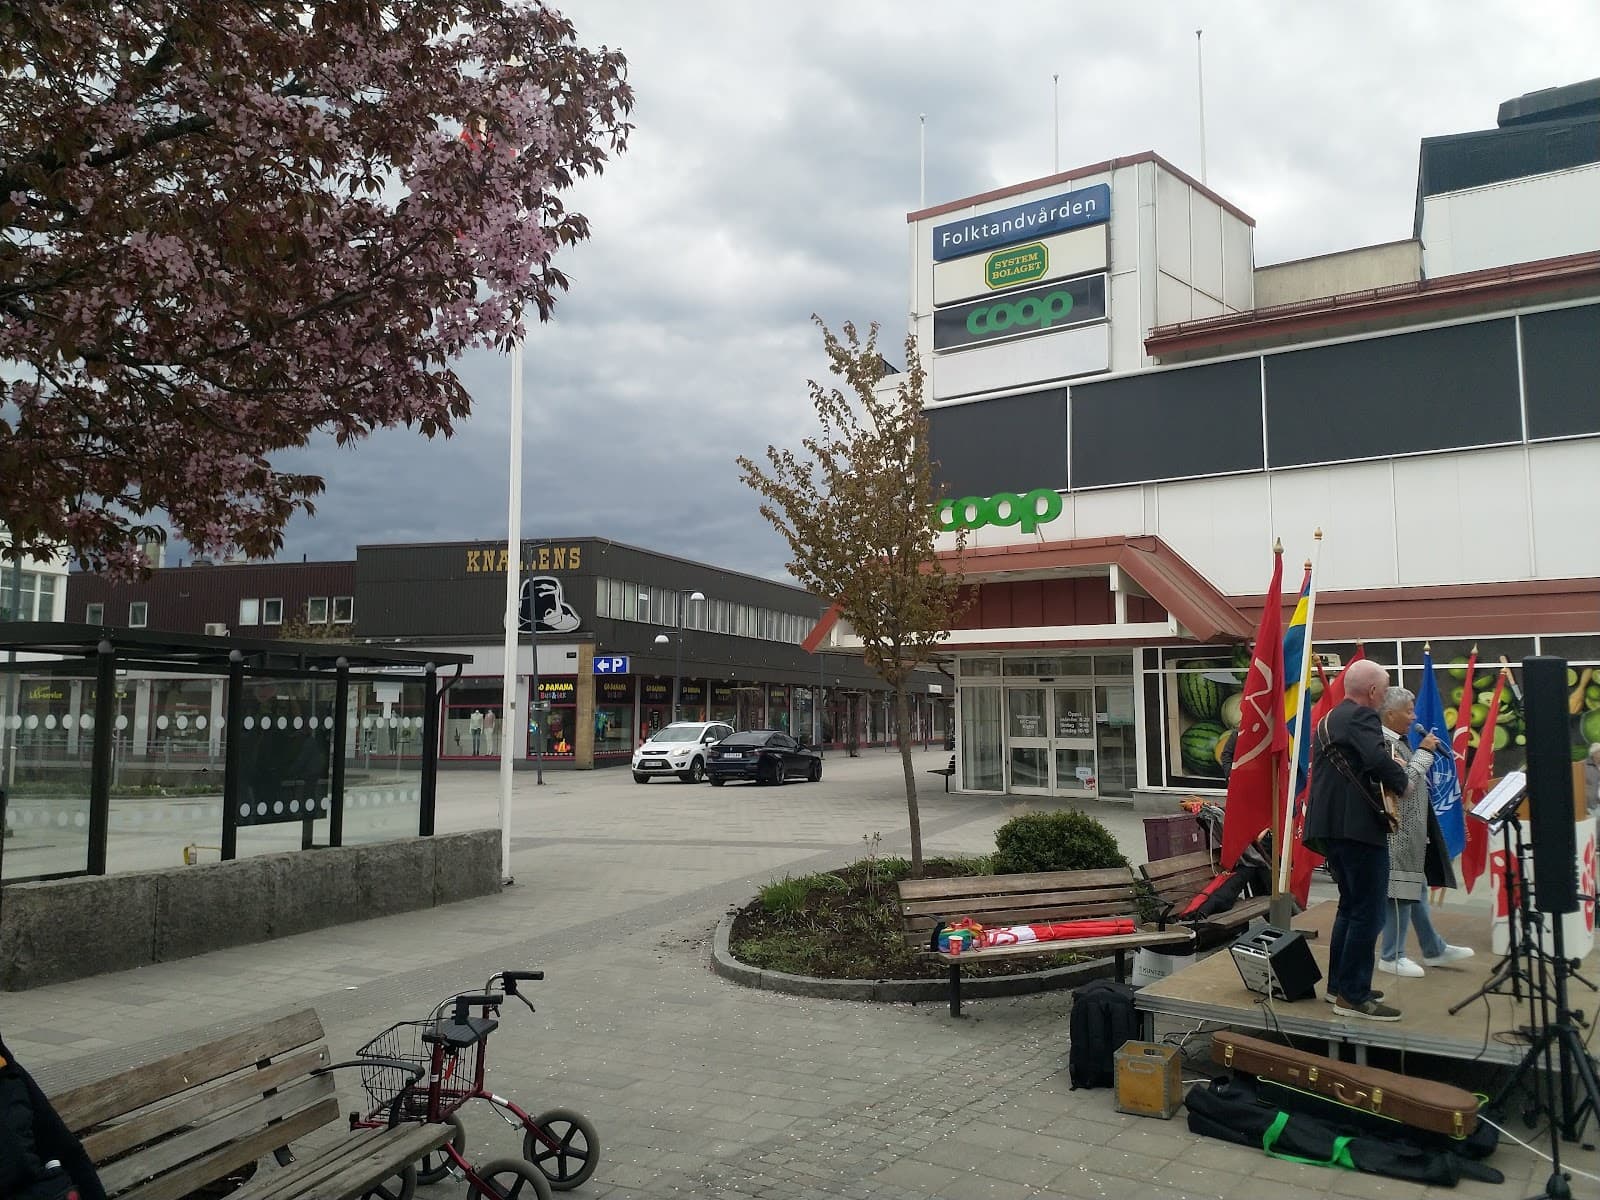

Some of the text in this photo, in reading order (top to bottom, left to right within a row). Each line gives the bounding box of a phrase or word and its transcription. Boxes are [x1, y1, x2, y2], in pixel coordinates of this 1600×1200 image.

[942, 198, 1096, 248] Folktandvården
[991, 261, 1042, 280] BOLAGET
[994, 252, 1039, 270] SYSTEM
[966, 290, 1074, 335] coop
[933, 488, 1063, 534] coop
[466, 547, 581, 572] KNAENS
[612, 659, 623, 673] P
[545, 683, 573, 691] BANANA
